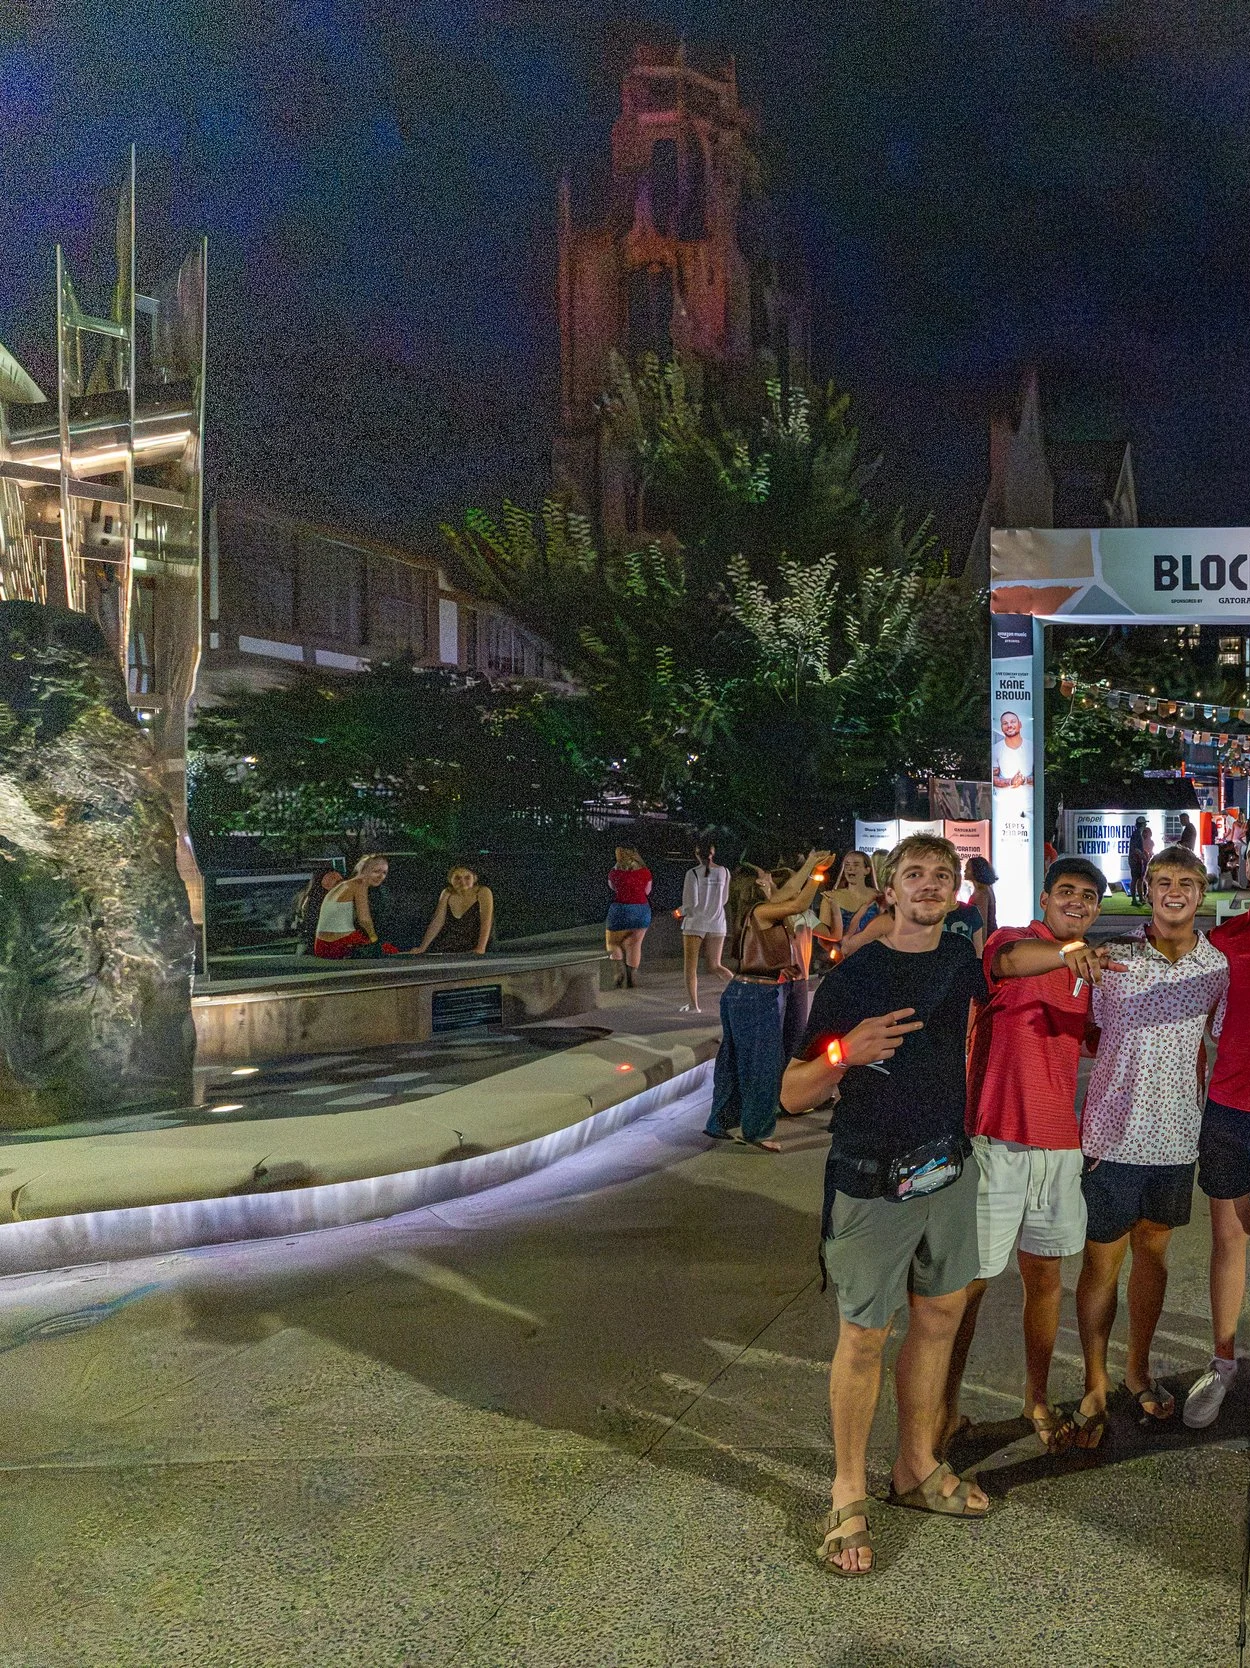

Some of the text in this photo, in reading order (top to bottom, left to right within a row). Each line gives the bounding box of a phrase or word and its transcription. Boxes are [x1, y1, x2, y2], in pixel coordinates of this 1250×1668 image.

[999, 679, 1025, 690] KANE
[995, 690, 1031, 701] BROWN
[1077, 825, 1121, 839] HYDRATION
